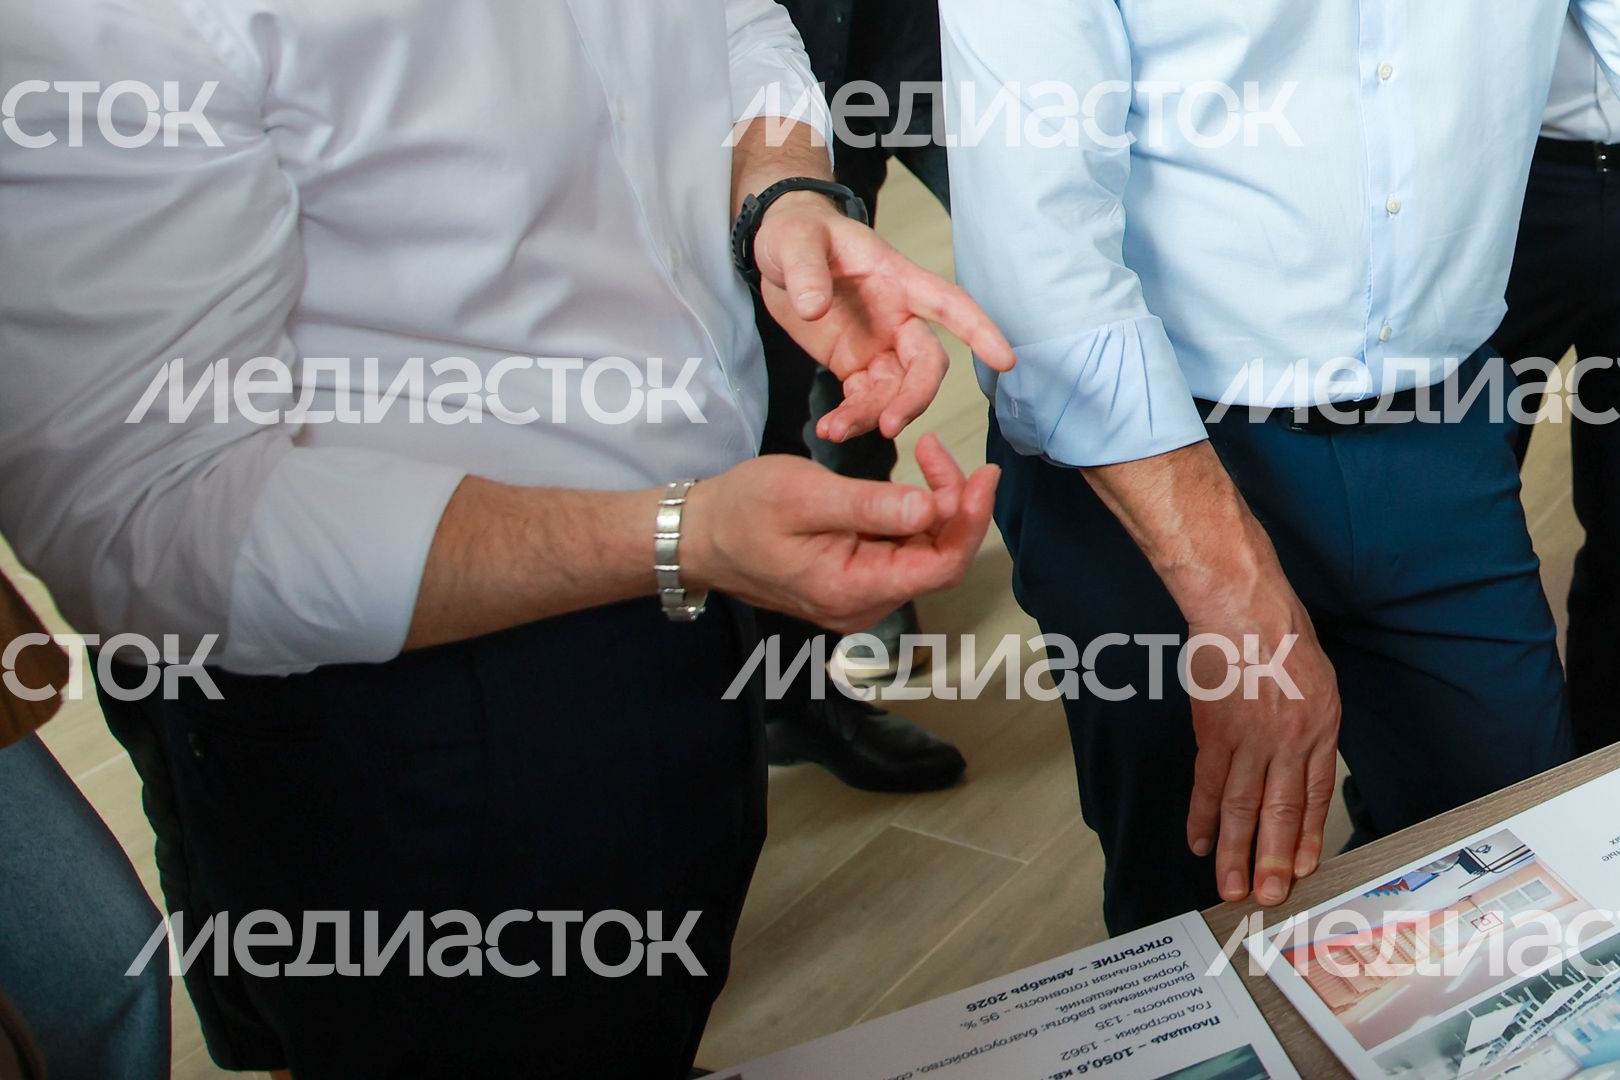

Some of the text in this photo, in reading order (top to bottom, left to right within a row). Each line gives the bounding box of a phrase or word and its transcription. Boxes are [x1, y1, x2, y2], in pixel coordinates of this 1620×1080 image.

[965, 935, 1173, 1012] ОТКРЫТИЕ декабрь 2026
[1055, 960, 1189, 1013] уборка помещений.
[1091, 948, 1181, 984] Строительная
[1014, 980, 1089, 1009] готовность
[1093, 985, 1203, 1031] Мощность 135
[916, 971, 1195, 1073] Выполняемые работы: благоустройство,
[1060, 999, 1212, 1061] Год постройки 1962
[1150, 1015, 1220, 1044] Площадь
[1076, 1046, 1134, 1074] 1050,6
